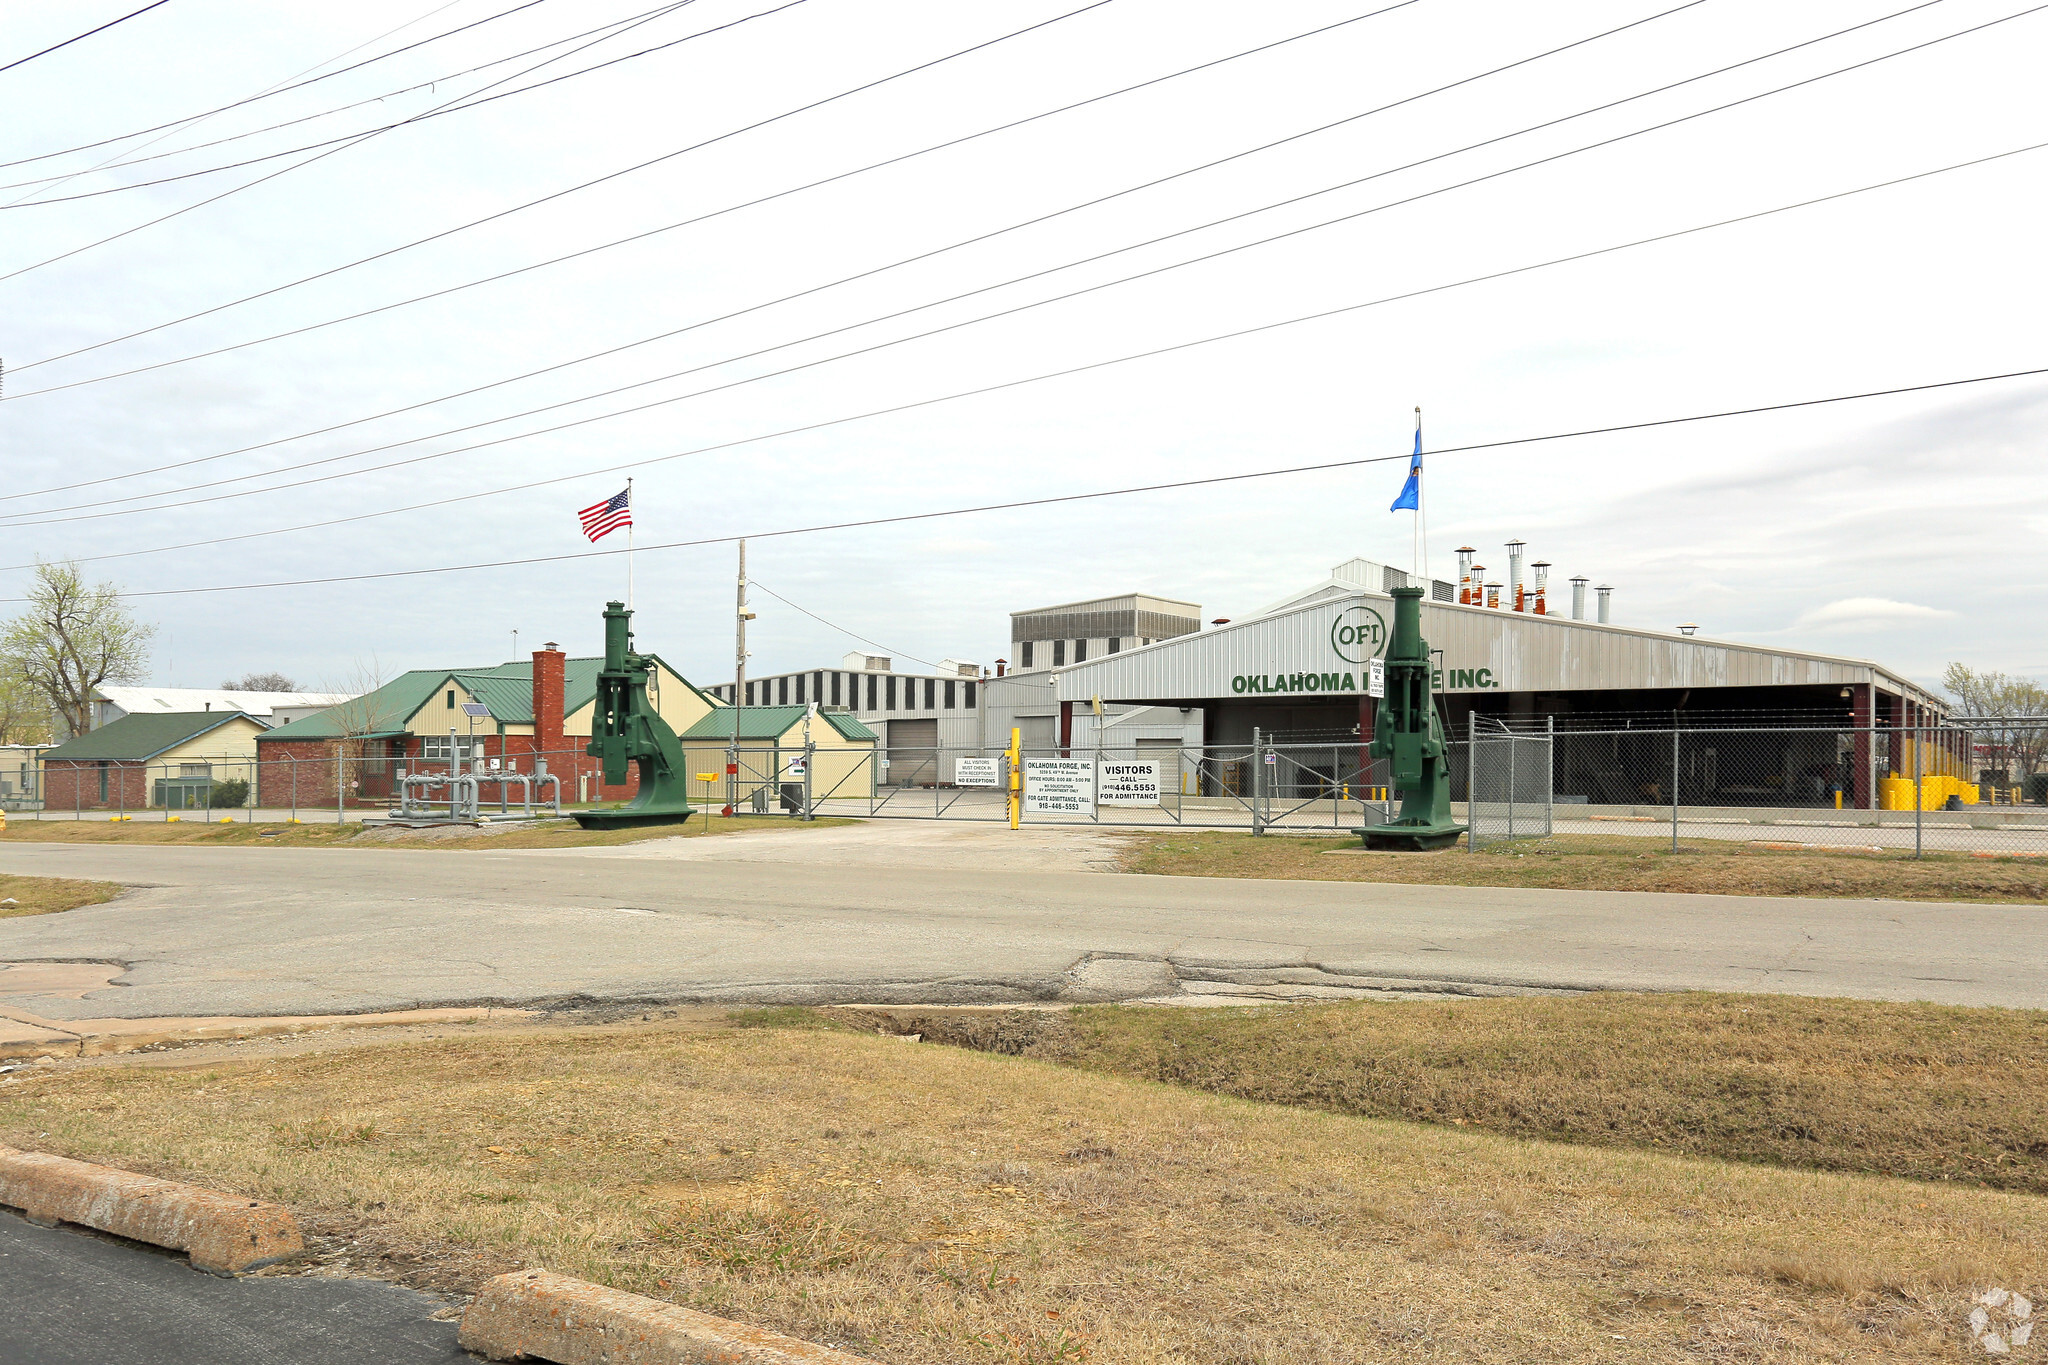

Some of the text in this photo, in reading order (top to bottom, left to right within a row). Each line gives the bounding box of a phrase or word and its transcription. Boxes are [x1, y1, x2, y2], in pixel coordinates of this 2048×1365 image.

[1338, 624, 1379, 646] OFI
[1232, 672, 1356, 694] OKLAHOMA
[1449, 668, 1499, 689] INC.
[1105, 766, 1152, 774] VISITORS
